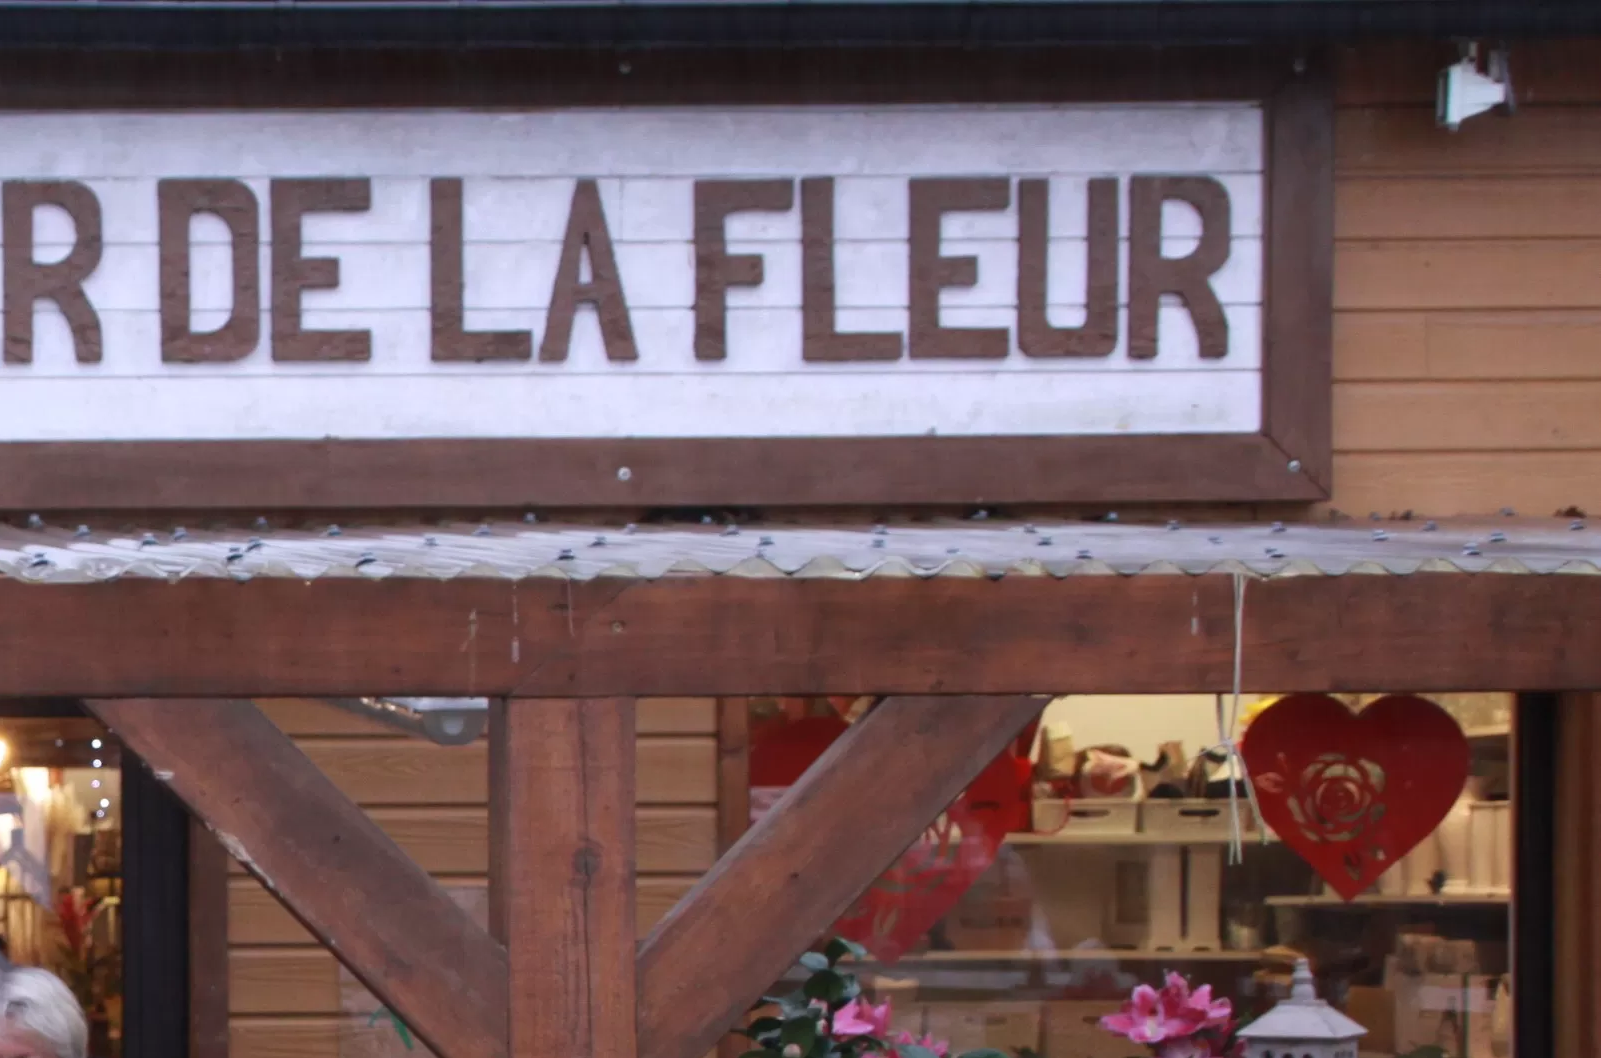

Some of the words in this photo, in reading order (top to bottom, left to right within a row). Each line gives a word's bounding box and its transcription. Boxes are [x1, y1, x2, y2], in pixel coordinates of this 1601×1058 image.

[157, 177, 372, 365] DE
[429, 176, 638, 365] LA
[690, 172, 1232, 364] FLEUR
